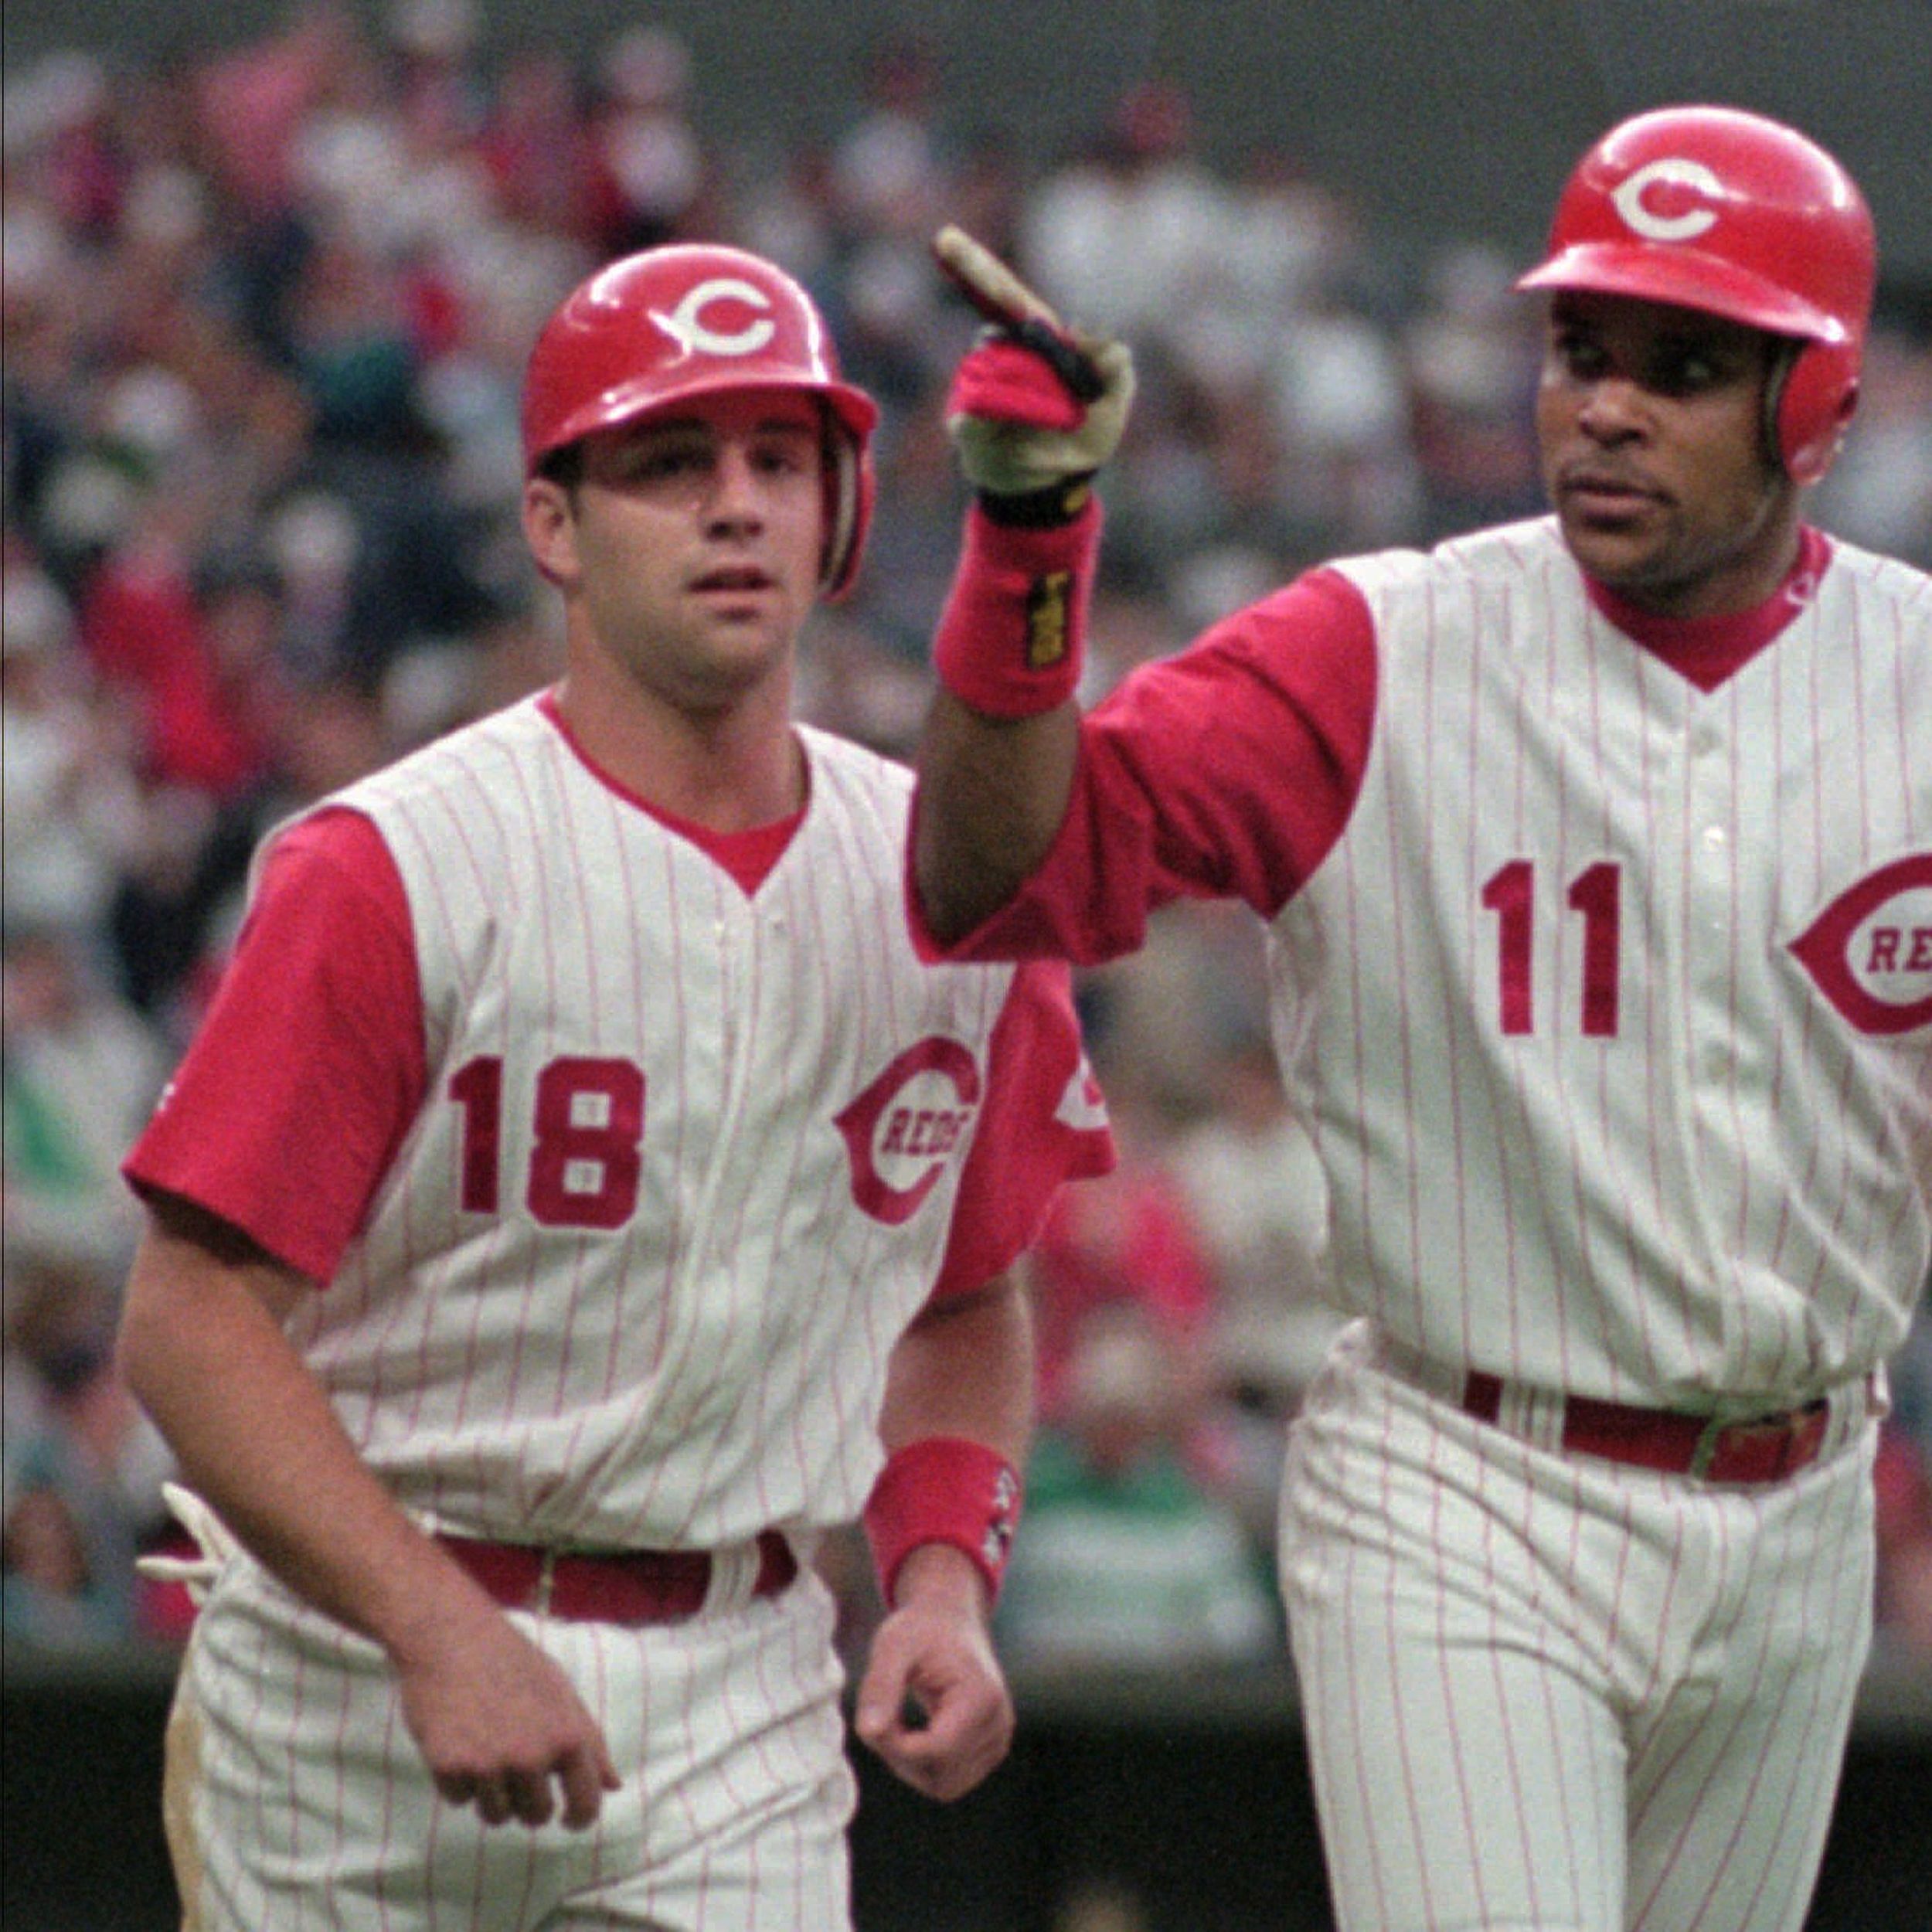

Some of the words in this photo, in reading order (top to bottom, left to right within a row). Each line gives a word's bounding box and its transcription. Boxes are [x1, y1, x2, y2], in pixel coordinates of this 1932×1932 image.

[1611, 158, 1726, 242] C
[665, 279, 775, 356] C
[1481, 858, 1621, 1039] 11
[448, 1053, 646, 1230] 18
